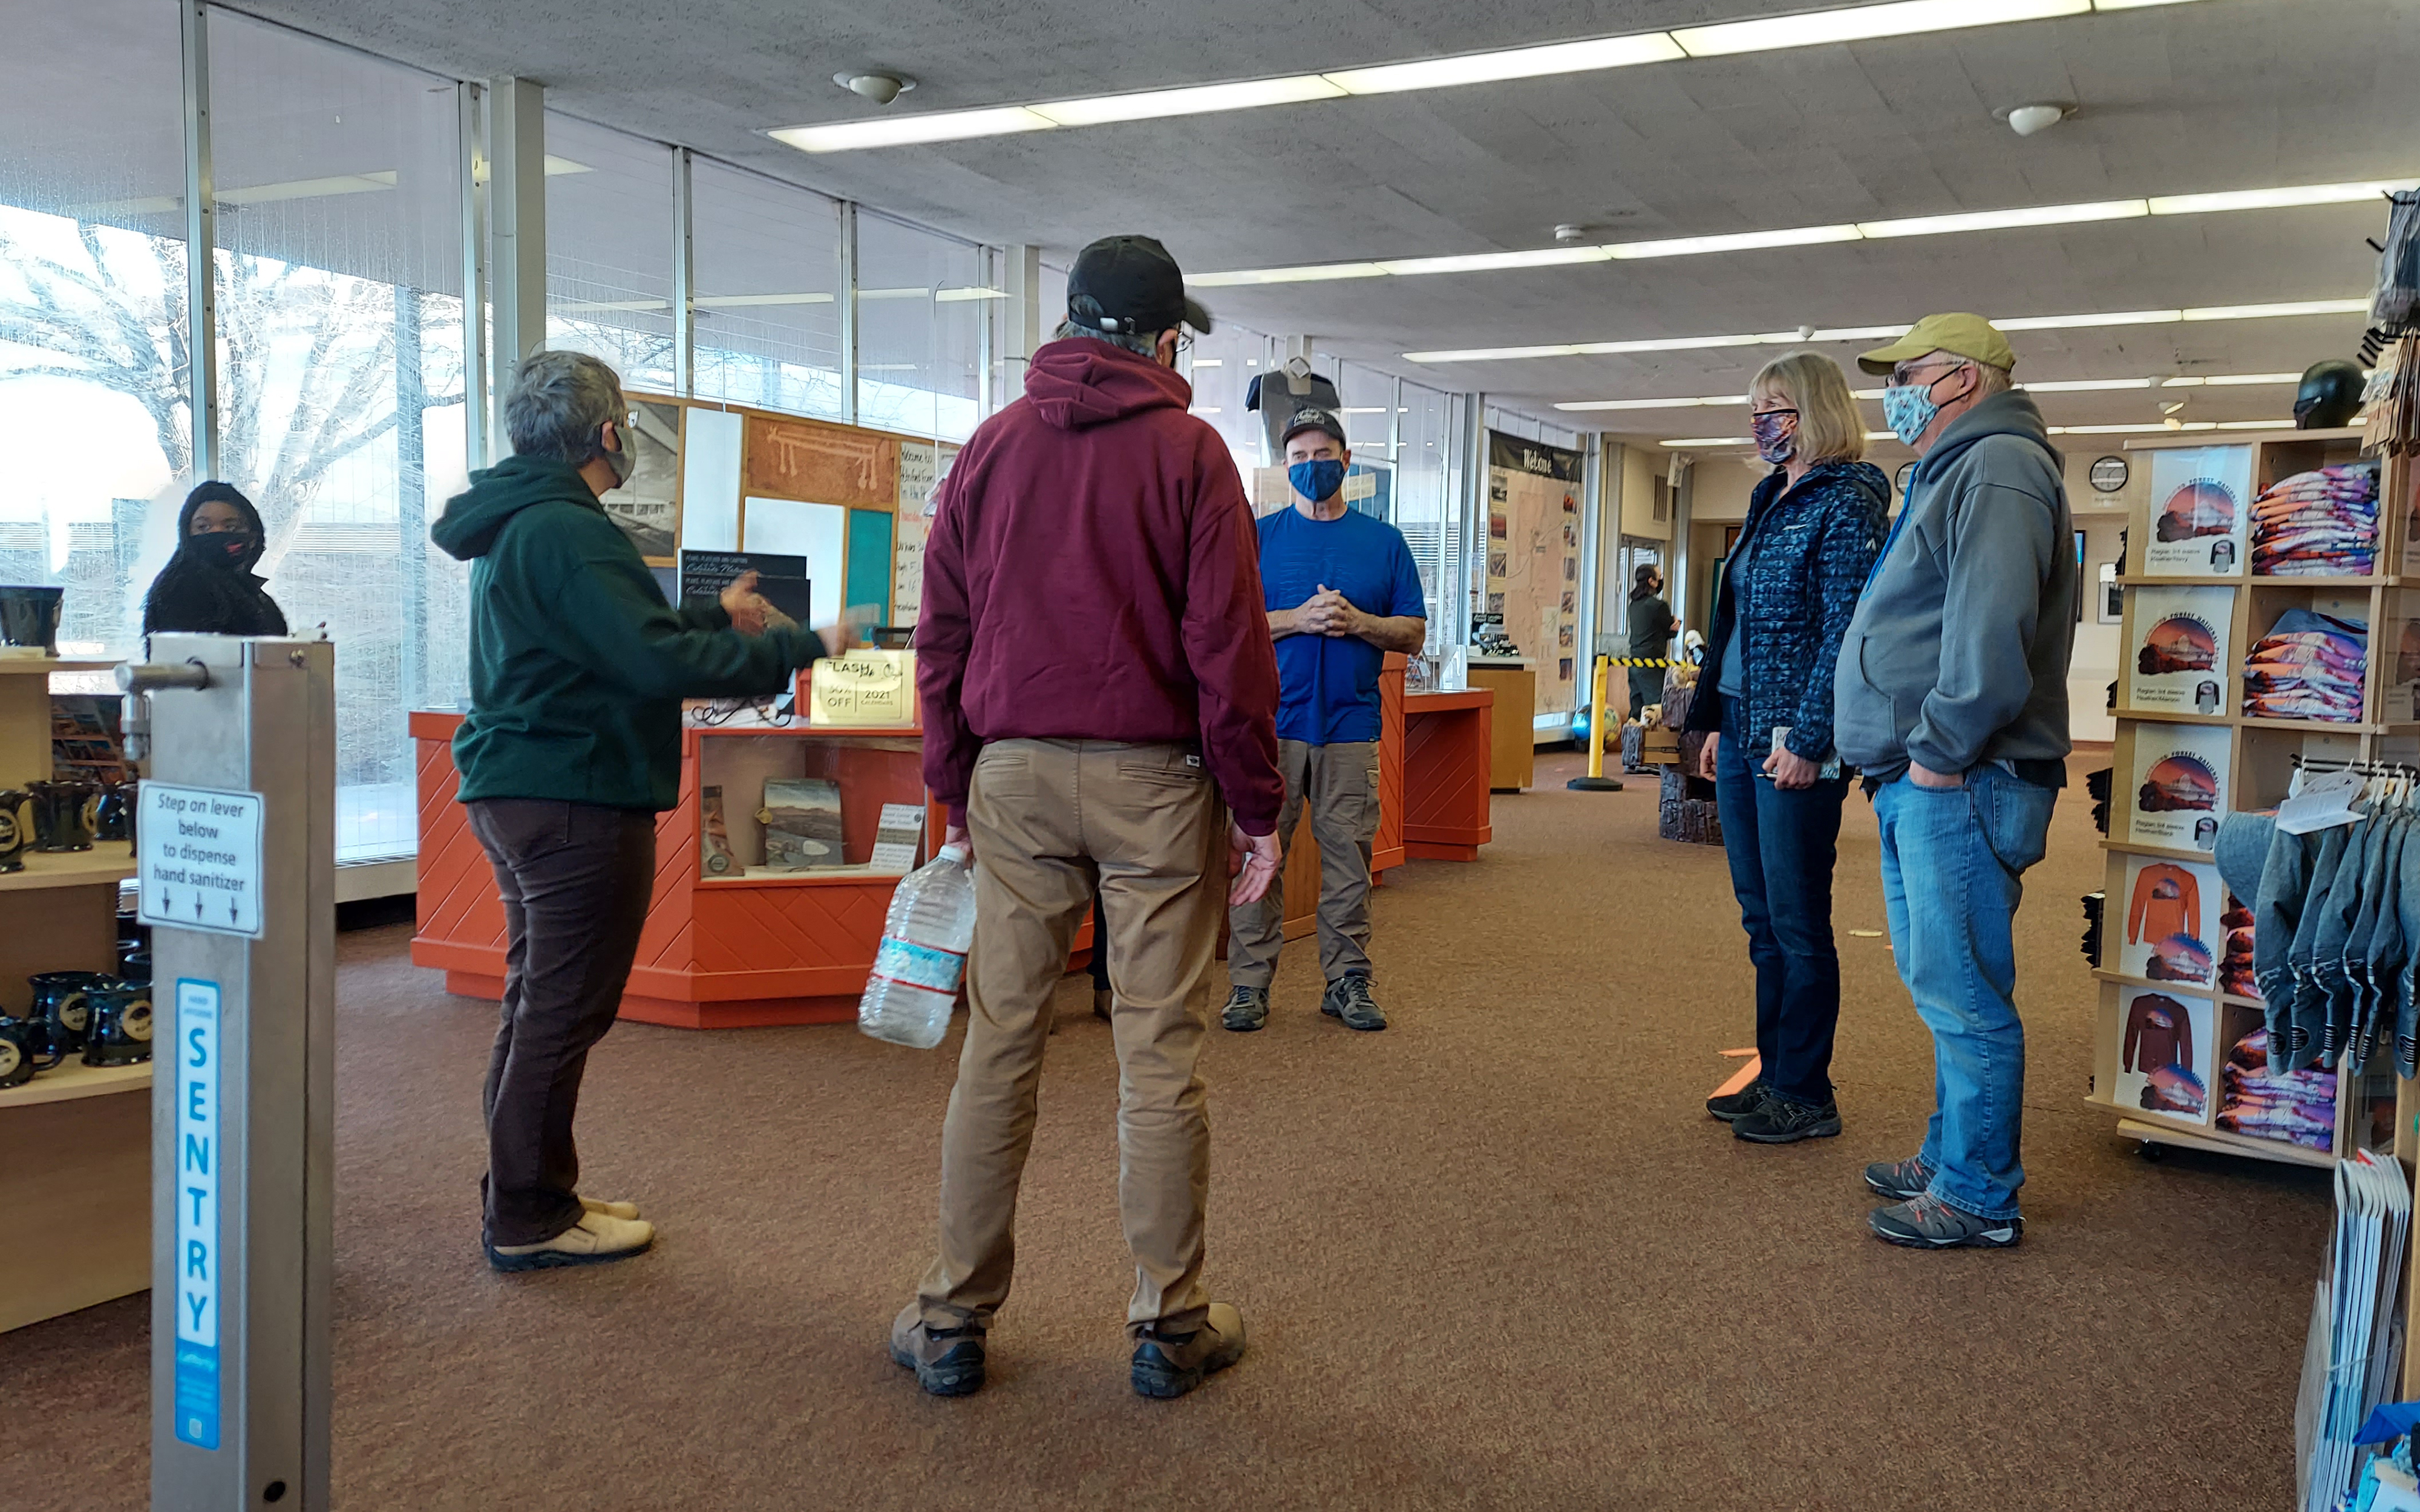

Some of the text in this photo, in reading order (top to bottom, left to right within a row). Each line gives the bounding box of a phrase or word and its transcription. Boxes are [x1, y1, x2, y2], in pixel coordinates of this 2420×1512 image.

[827, 697, 852, 708] OFF
[865, 689, 890, 699] 2021
[158, 793, 244, 817] Step on lever
[178, 819, 218, 839] below
[163, 843, 236, 866] to dispense
[154, 864, 244, 891] hand sanitizer
[186, 1028, 209, 1332] SENTRY
